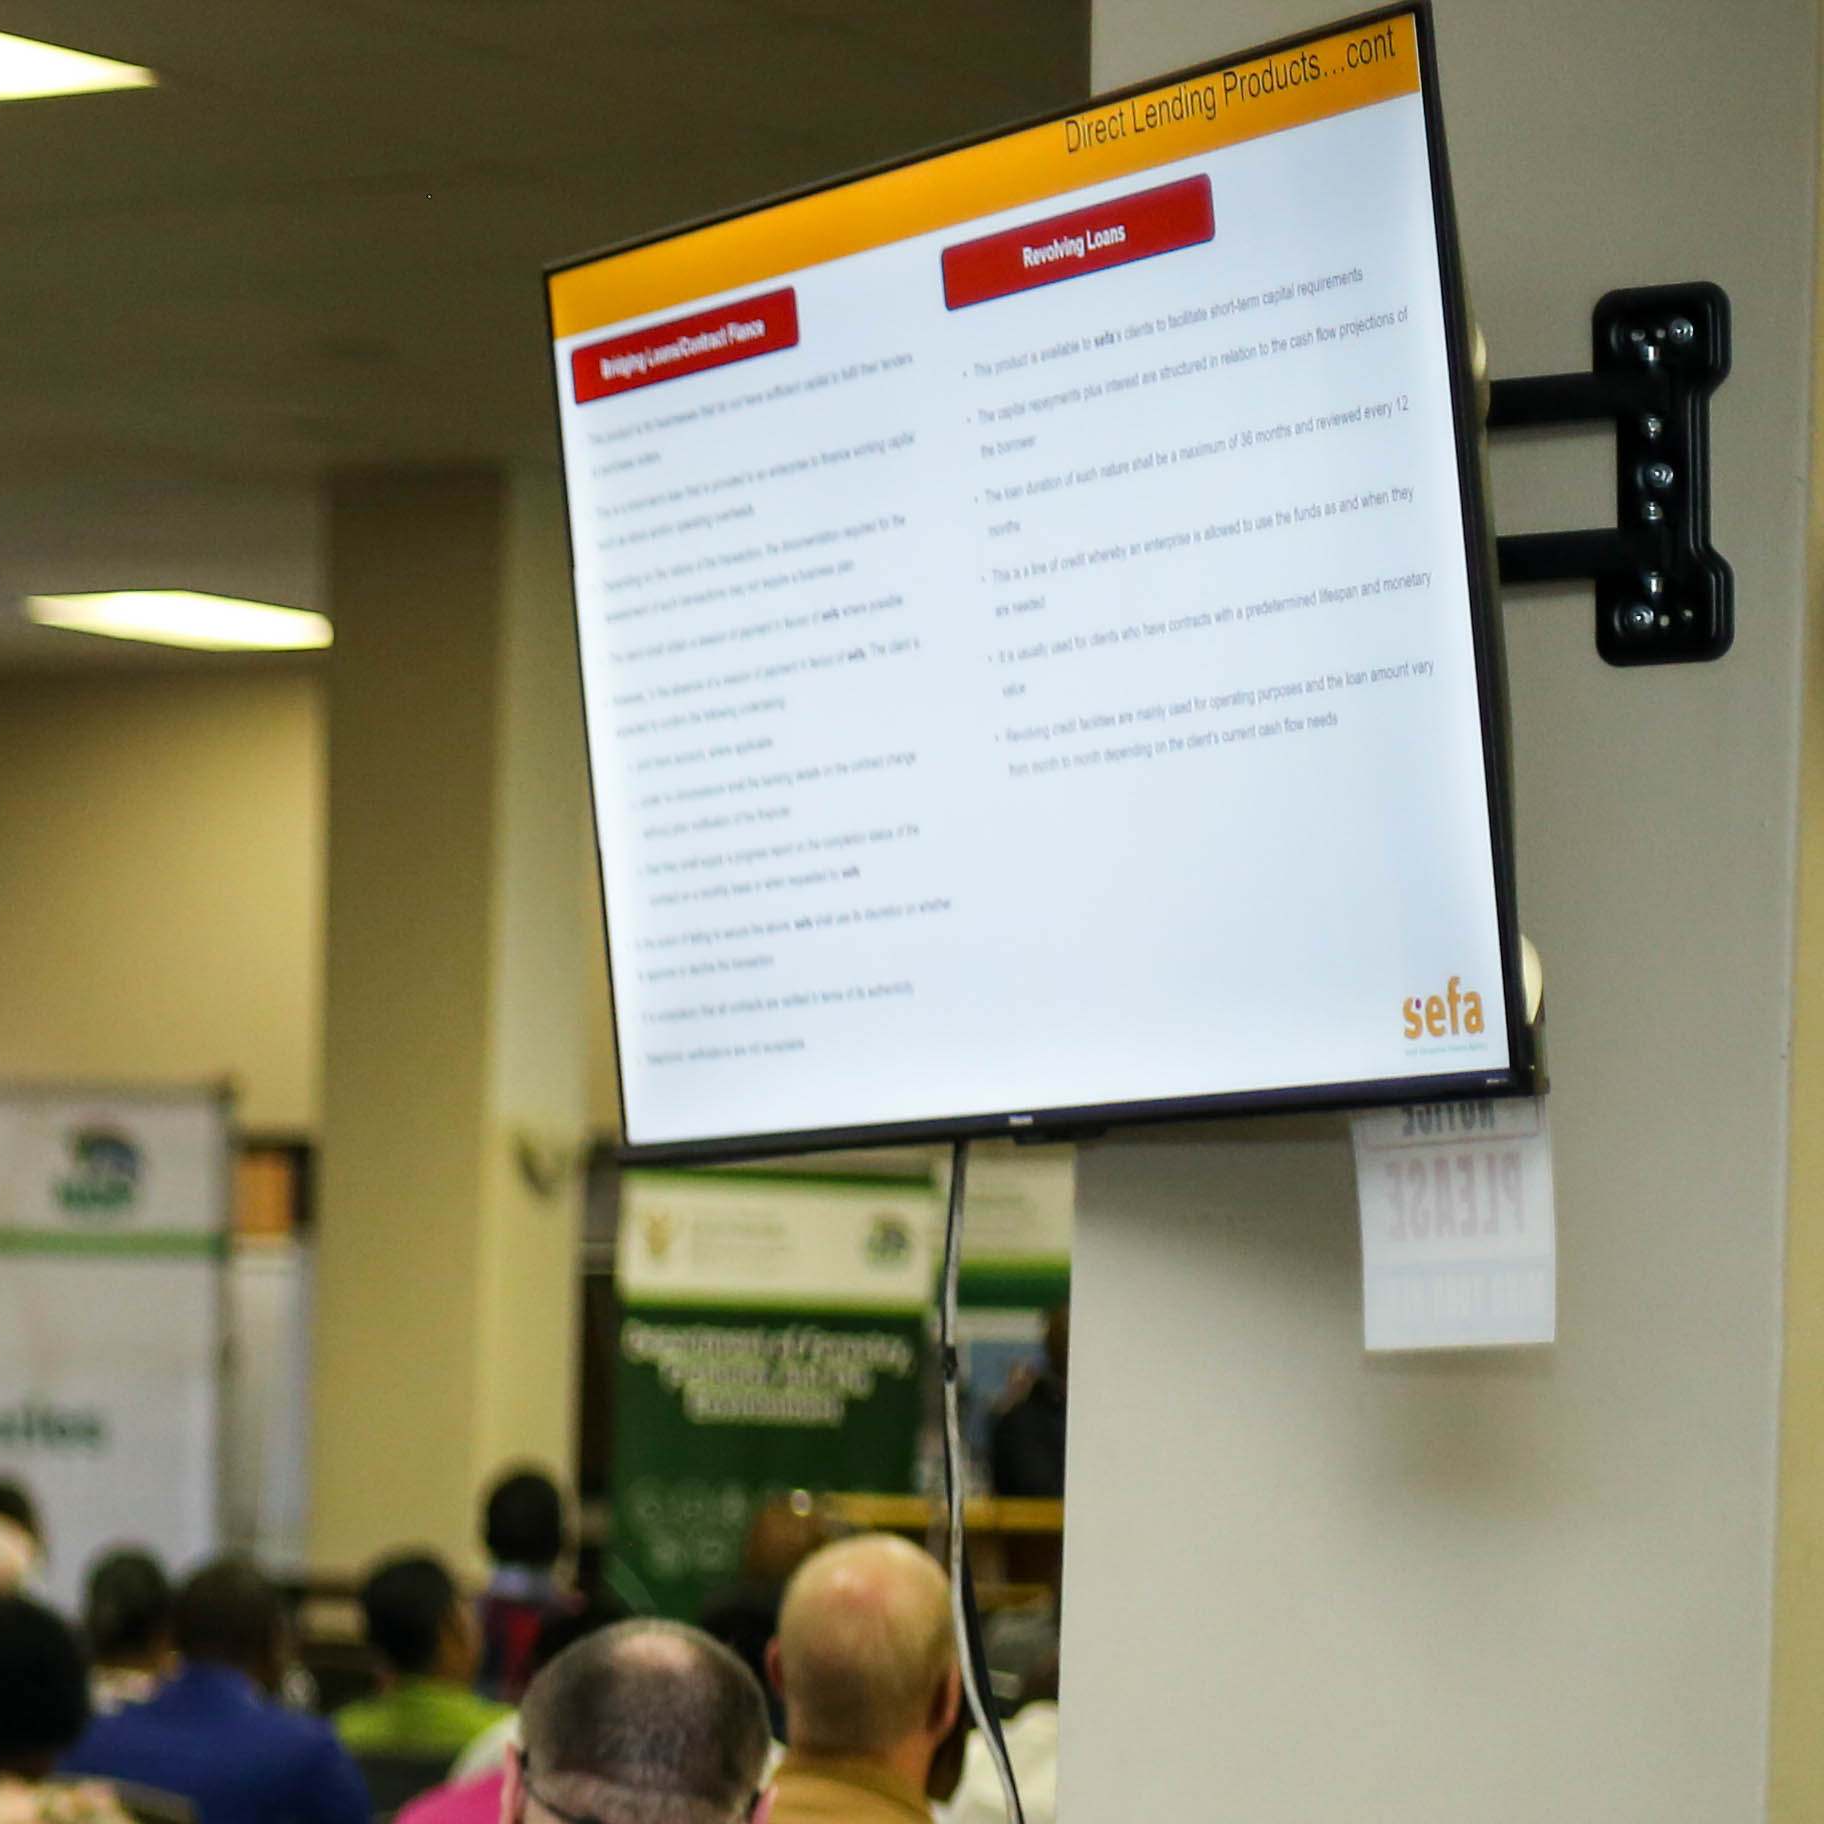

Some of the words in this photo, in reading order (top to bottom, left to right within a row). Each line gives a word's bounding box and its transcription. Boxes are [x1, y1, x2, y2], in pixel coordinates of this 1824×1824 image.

[1064, 108, 1127, 153] Direct
[1131, 85, 1217, 133] Lending
[1022, 231, 1086, 268] Revolving
[1086, 224, 1126, 252] Loans
[1209, 295, 1259, 318] short-term
[1262, 283, 1294, 305] capital
[1297, 267, 1362, 297] requirements
[1221, 345, 1256, 366] relation
[1290, 329, 1313, 349] cash
[1316, 326, 1336, 343] flow
[1339, 313, 1394, 340] projections
[1255, 422, 1291, 443] months
[1316, 405, 1360, 430] reviewed
[1364, 403, 1392, 419] every
[1294, 503, 1321, 522] funds
[1361, 490, 1388, 508] when
[1391, 485, 1413, 502] they
[1245, 590, 1316, 620] predetermined
[1319, 586, 1357, 604] lifespan
[1383, 571, 1431, 592] monetary
[1257, 683, 1302, 703] purposes
[1345, 671, 1367, 686] loan
[1370, 661, 1408, 682] amount
[1411, 661, 1433, 675] vary
[1258, 719, 1281, 736] cash
[1284, 718, 1304, 732] flow
[1307, 711, 1337, 728] needs
[1402, 975, 1485, 1040] sefa
